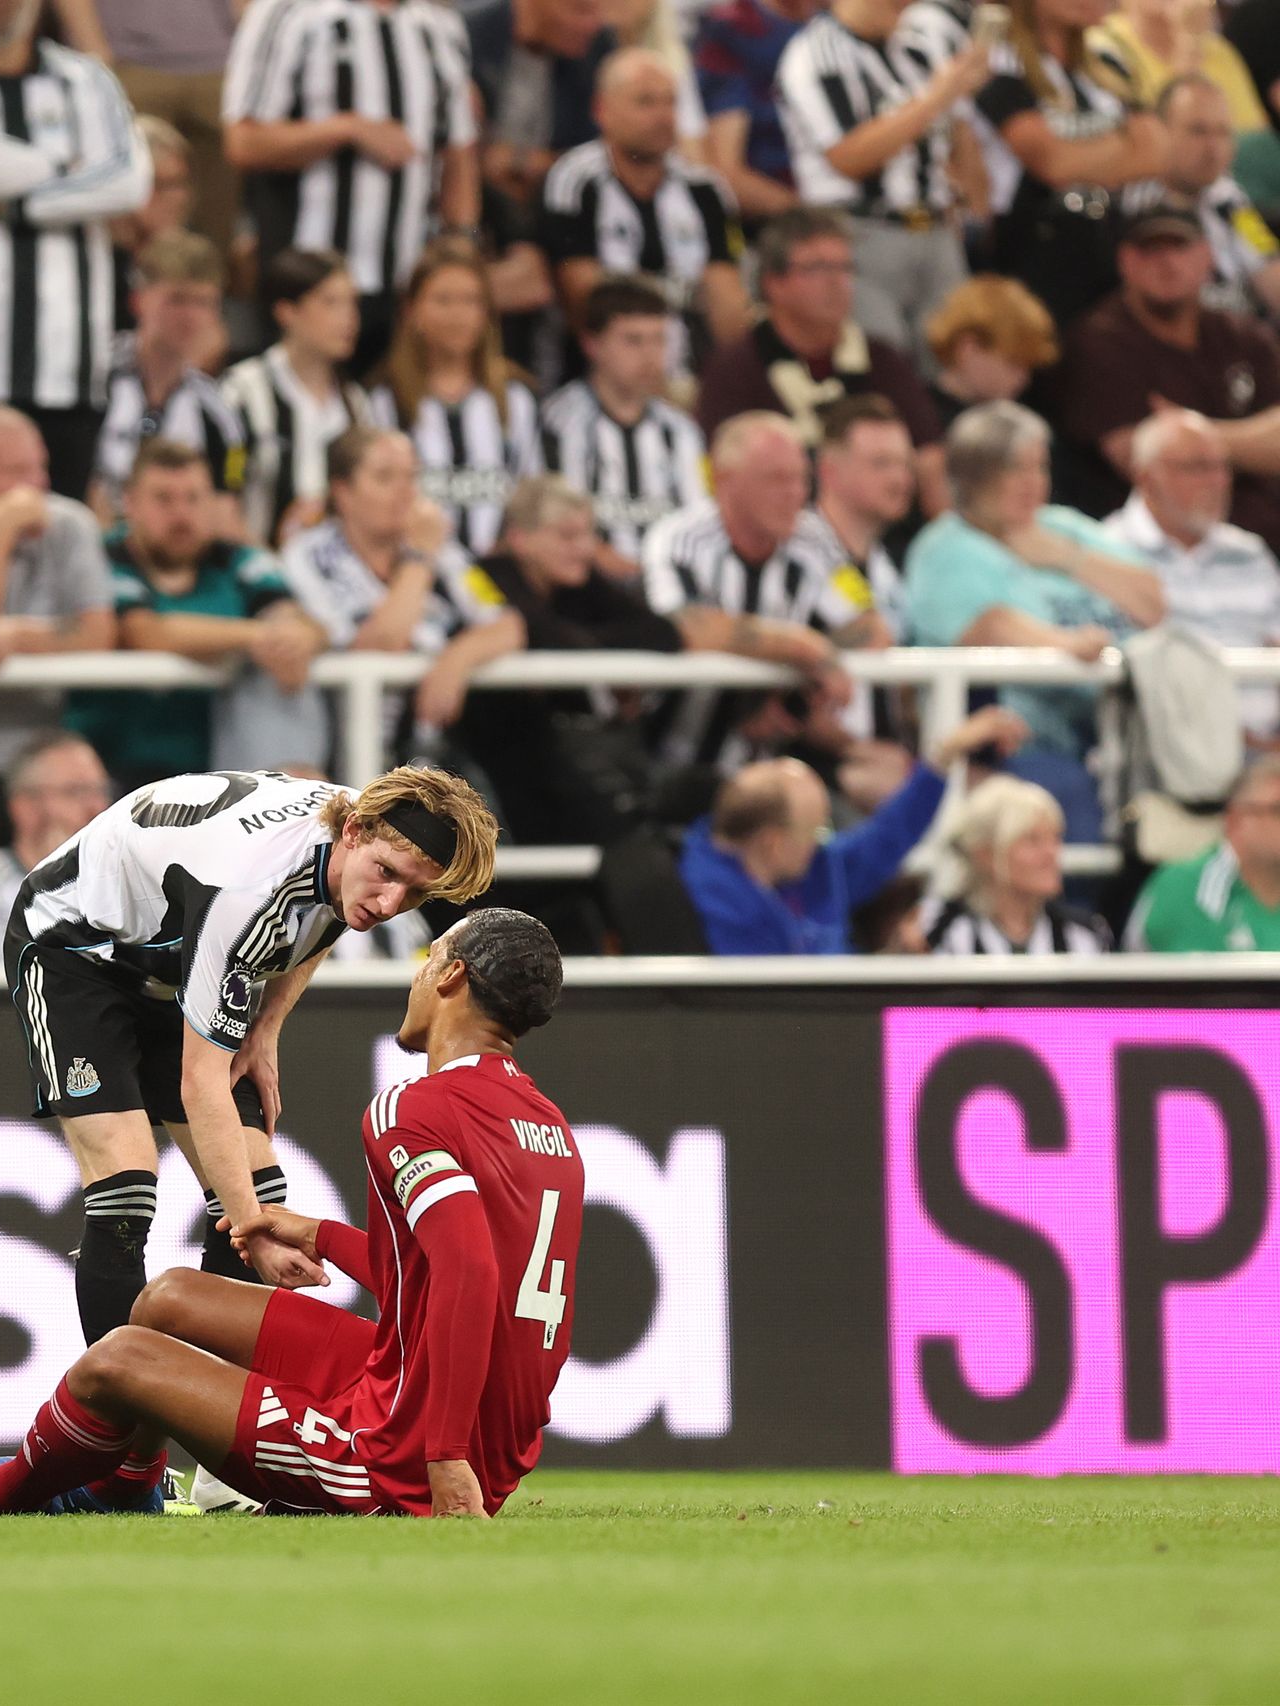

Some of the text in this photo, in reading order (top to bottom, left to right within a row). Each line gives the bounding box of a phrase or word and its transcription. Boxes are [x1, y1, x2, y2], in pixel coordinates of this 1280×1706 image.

[210, 1008, 227, 1022] No
[509, 1117, 573, 1158] VIRGIL
[917, 1035, 1271, 1450] SP
[514, 1188, 567, 1350] 4
[292, 1406, 352, 1446] 4
